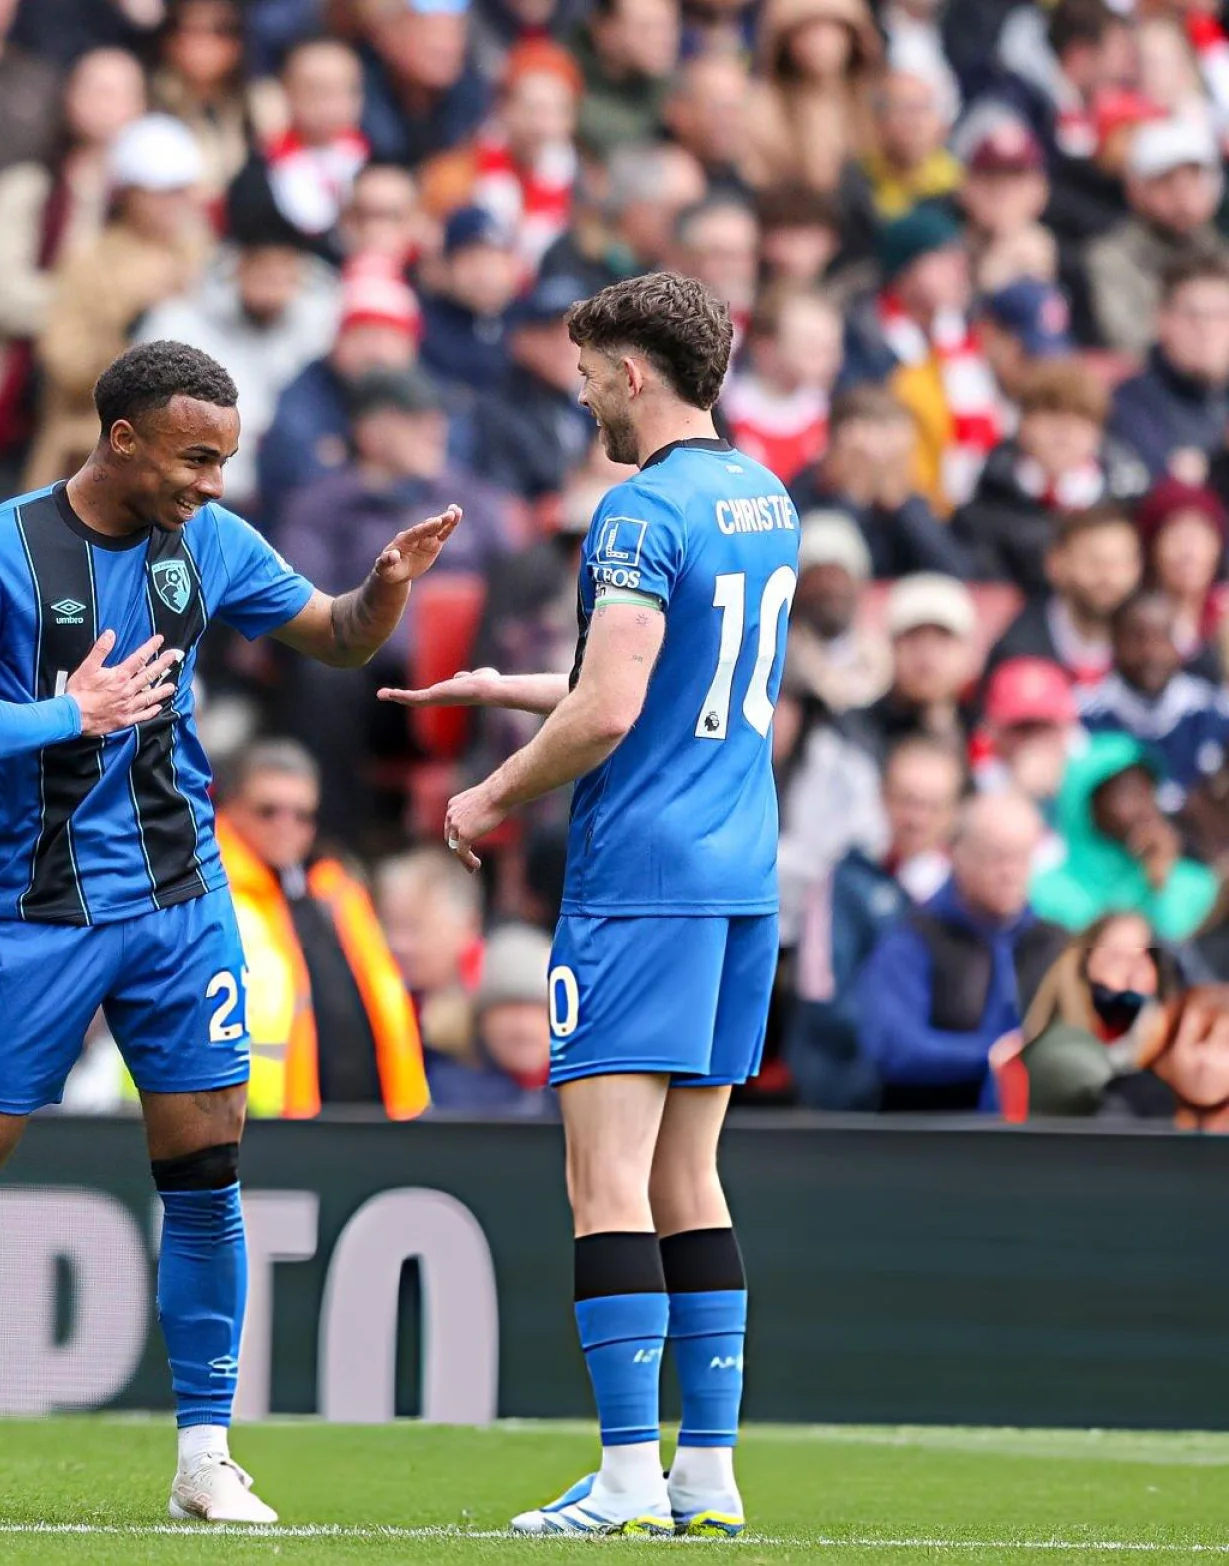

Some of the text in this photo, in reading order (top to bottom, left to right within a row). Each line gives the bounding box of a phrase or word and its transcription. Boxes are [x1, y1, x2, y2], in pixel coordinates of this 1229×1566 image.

[716, 495, 795, 535] CHRISTIE
[56, 616, 84, 625] umbro
[694, 564, 797, 740] 10
[205, 965, 249, 1043] 2
